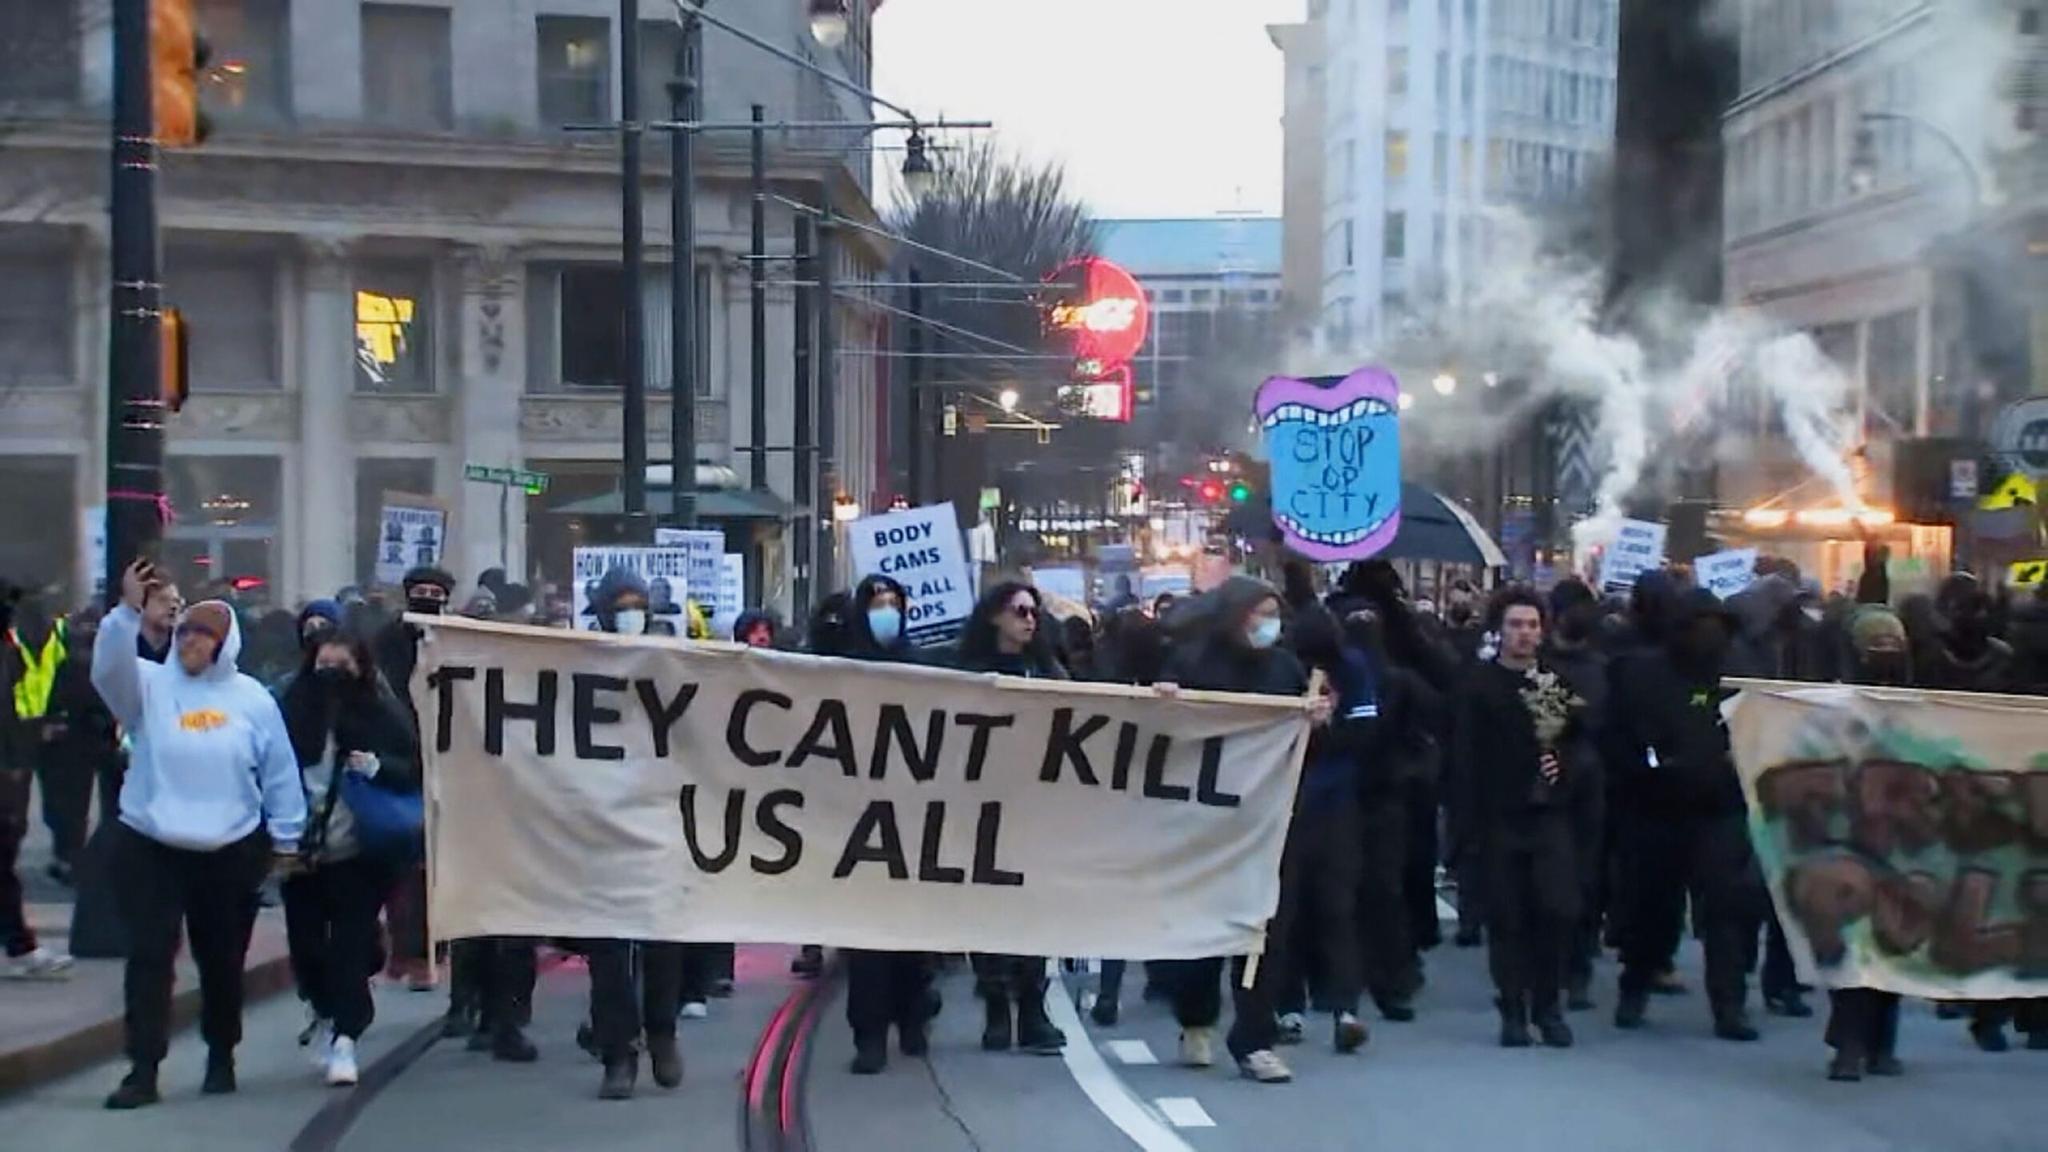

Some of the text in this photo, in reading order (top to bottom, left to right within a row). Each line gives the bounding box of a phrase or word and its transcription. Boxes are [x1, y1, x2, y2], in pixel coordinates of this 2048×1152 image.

[1293, 425, 1374, 468] STOP
[1290, 488, 1378, 519] CITY
[874, 521, 932, 548] BODY
[577, 553, 603, 577] HOW
[880, 547, 940, 573] CAMS
[921, 576, 956, 597] ALL
[907, 600, 947, 621] OPS
[426, 666, 1241, 808] THEY CANT KILL
[679, 784, 1025, 887] US ALL
